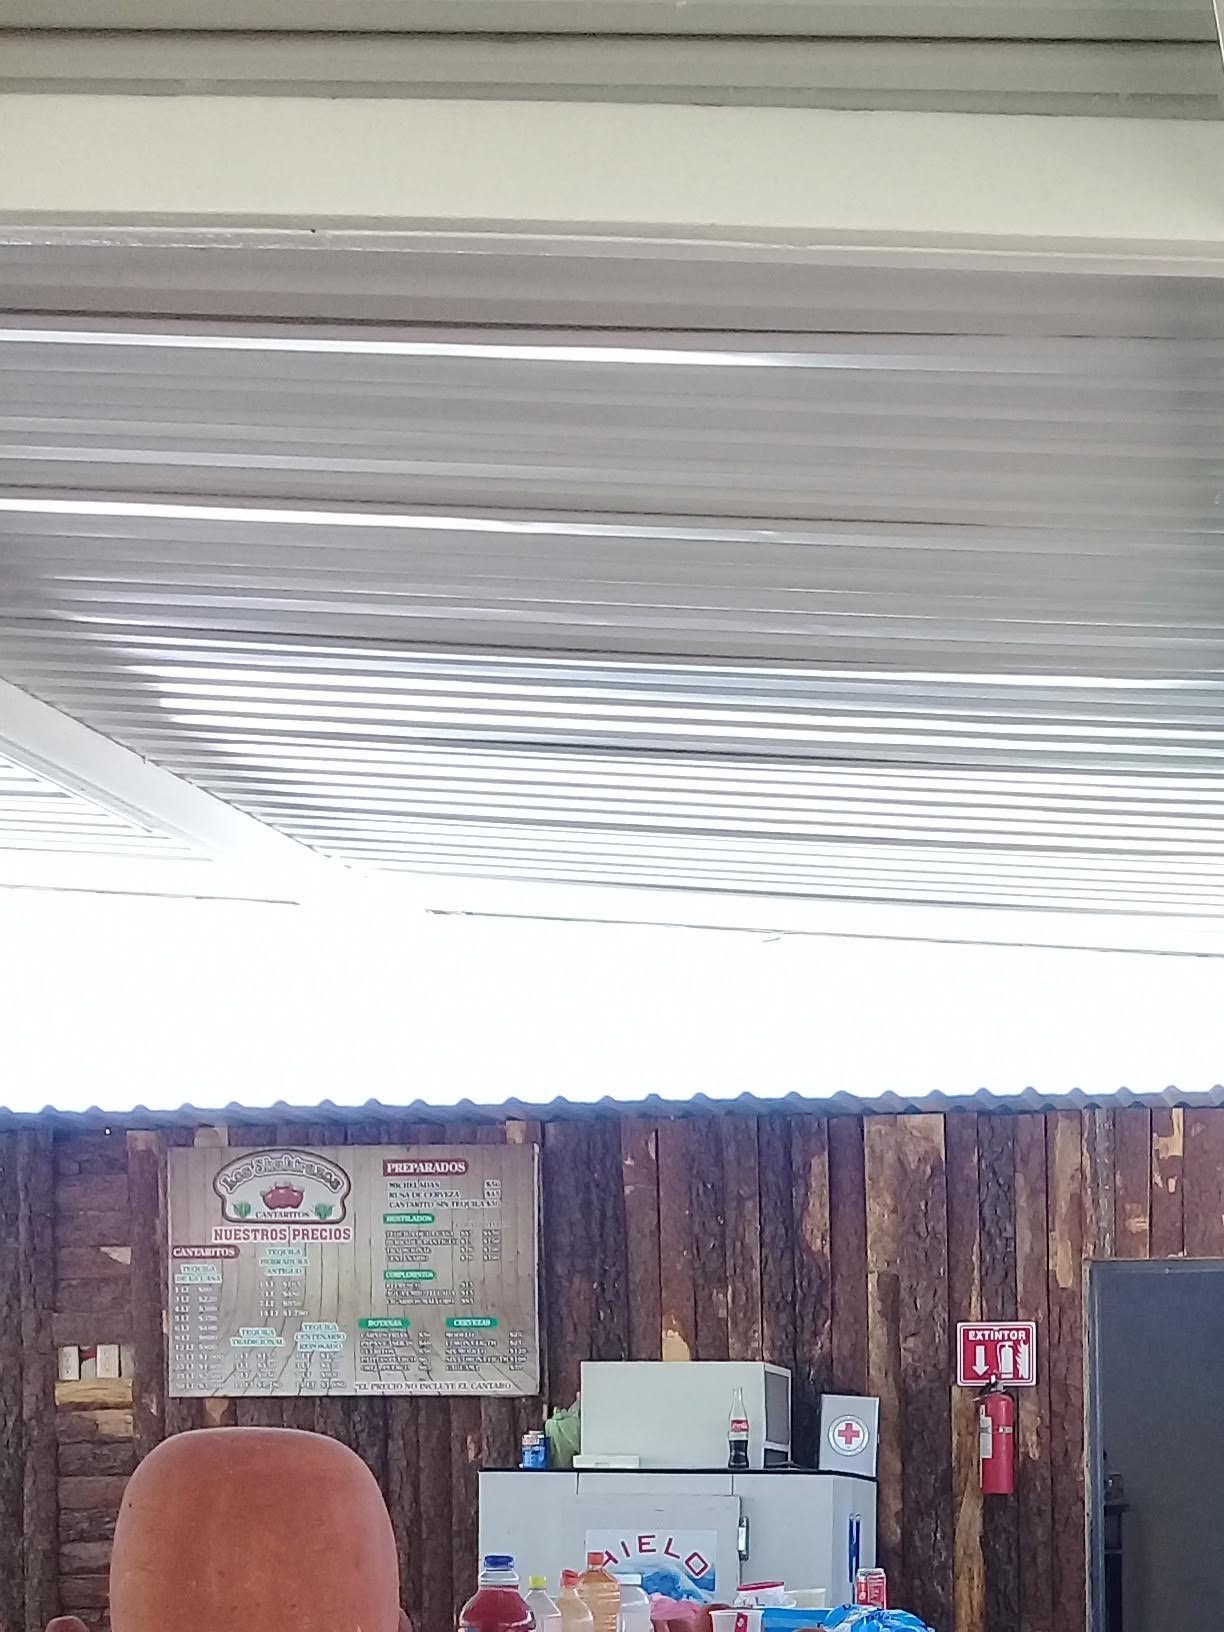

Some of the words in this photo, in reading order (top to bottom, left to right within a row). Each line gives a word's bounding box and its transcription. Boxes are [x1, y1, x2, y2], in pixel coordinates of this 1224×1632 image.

[386, 1161, 467, 1174] PREPARADOS
[255, 1210, 310, 1219] CANTARITOS
[213, 1227, 287, 1241] NUESTROS
[292, 1227, 351, 1241] PRECIOS
[173, 1247, 236, 1258] CANTARITOS
[453, 1318, 491, 1327] CERVEZAS
[968, 1330, 1026, 1341] EXTINTOR
[370, 1382, 403, 1391] PRECIO
[405, 1382, 418, 1391] NO
[419, 1382, 454, 1391] INCLUYE
[457, 1381, 468, 1390] EL
